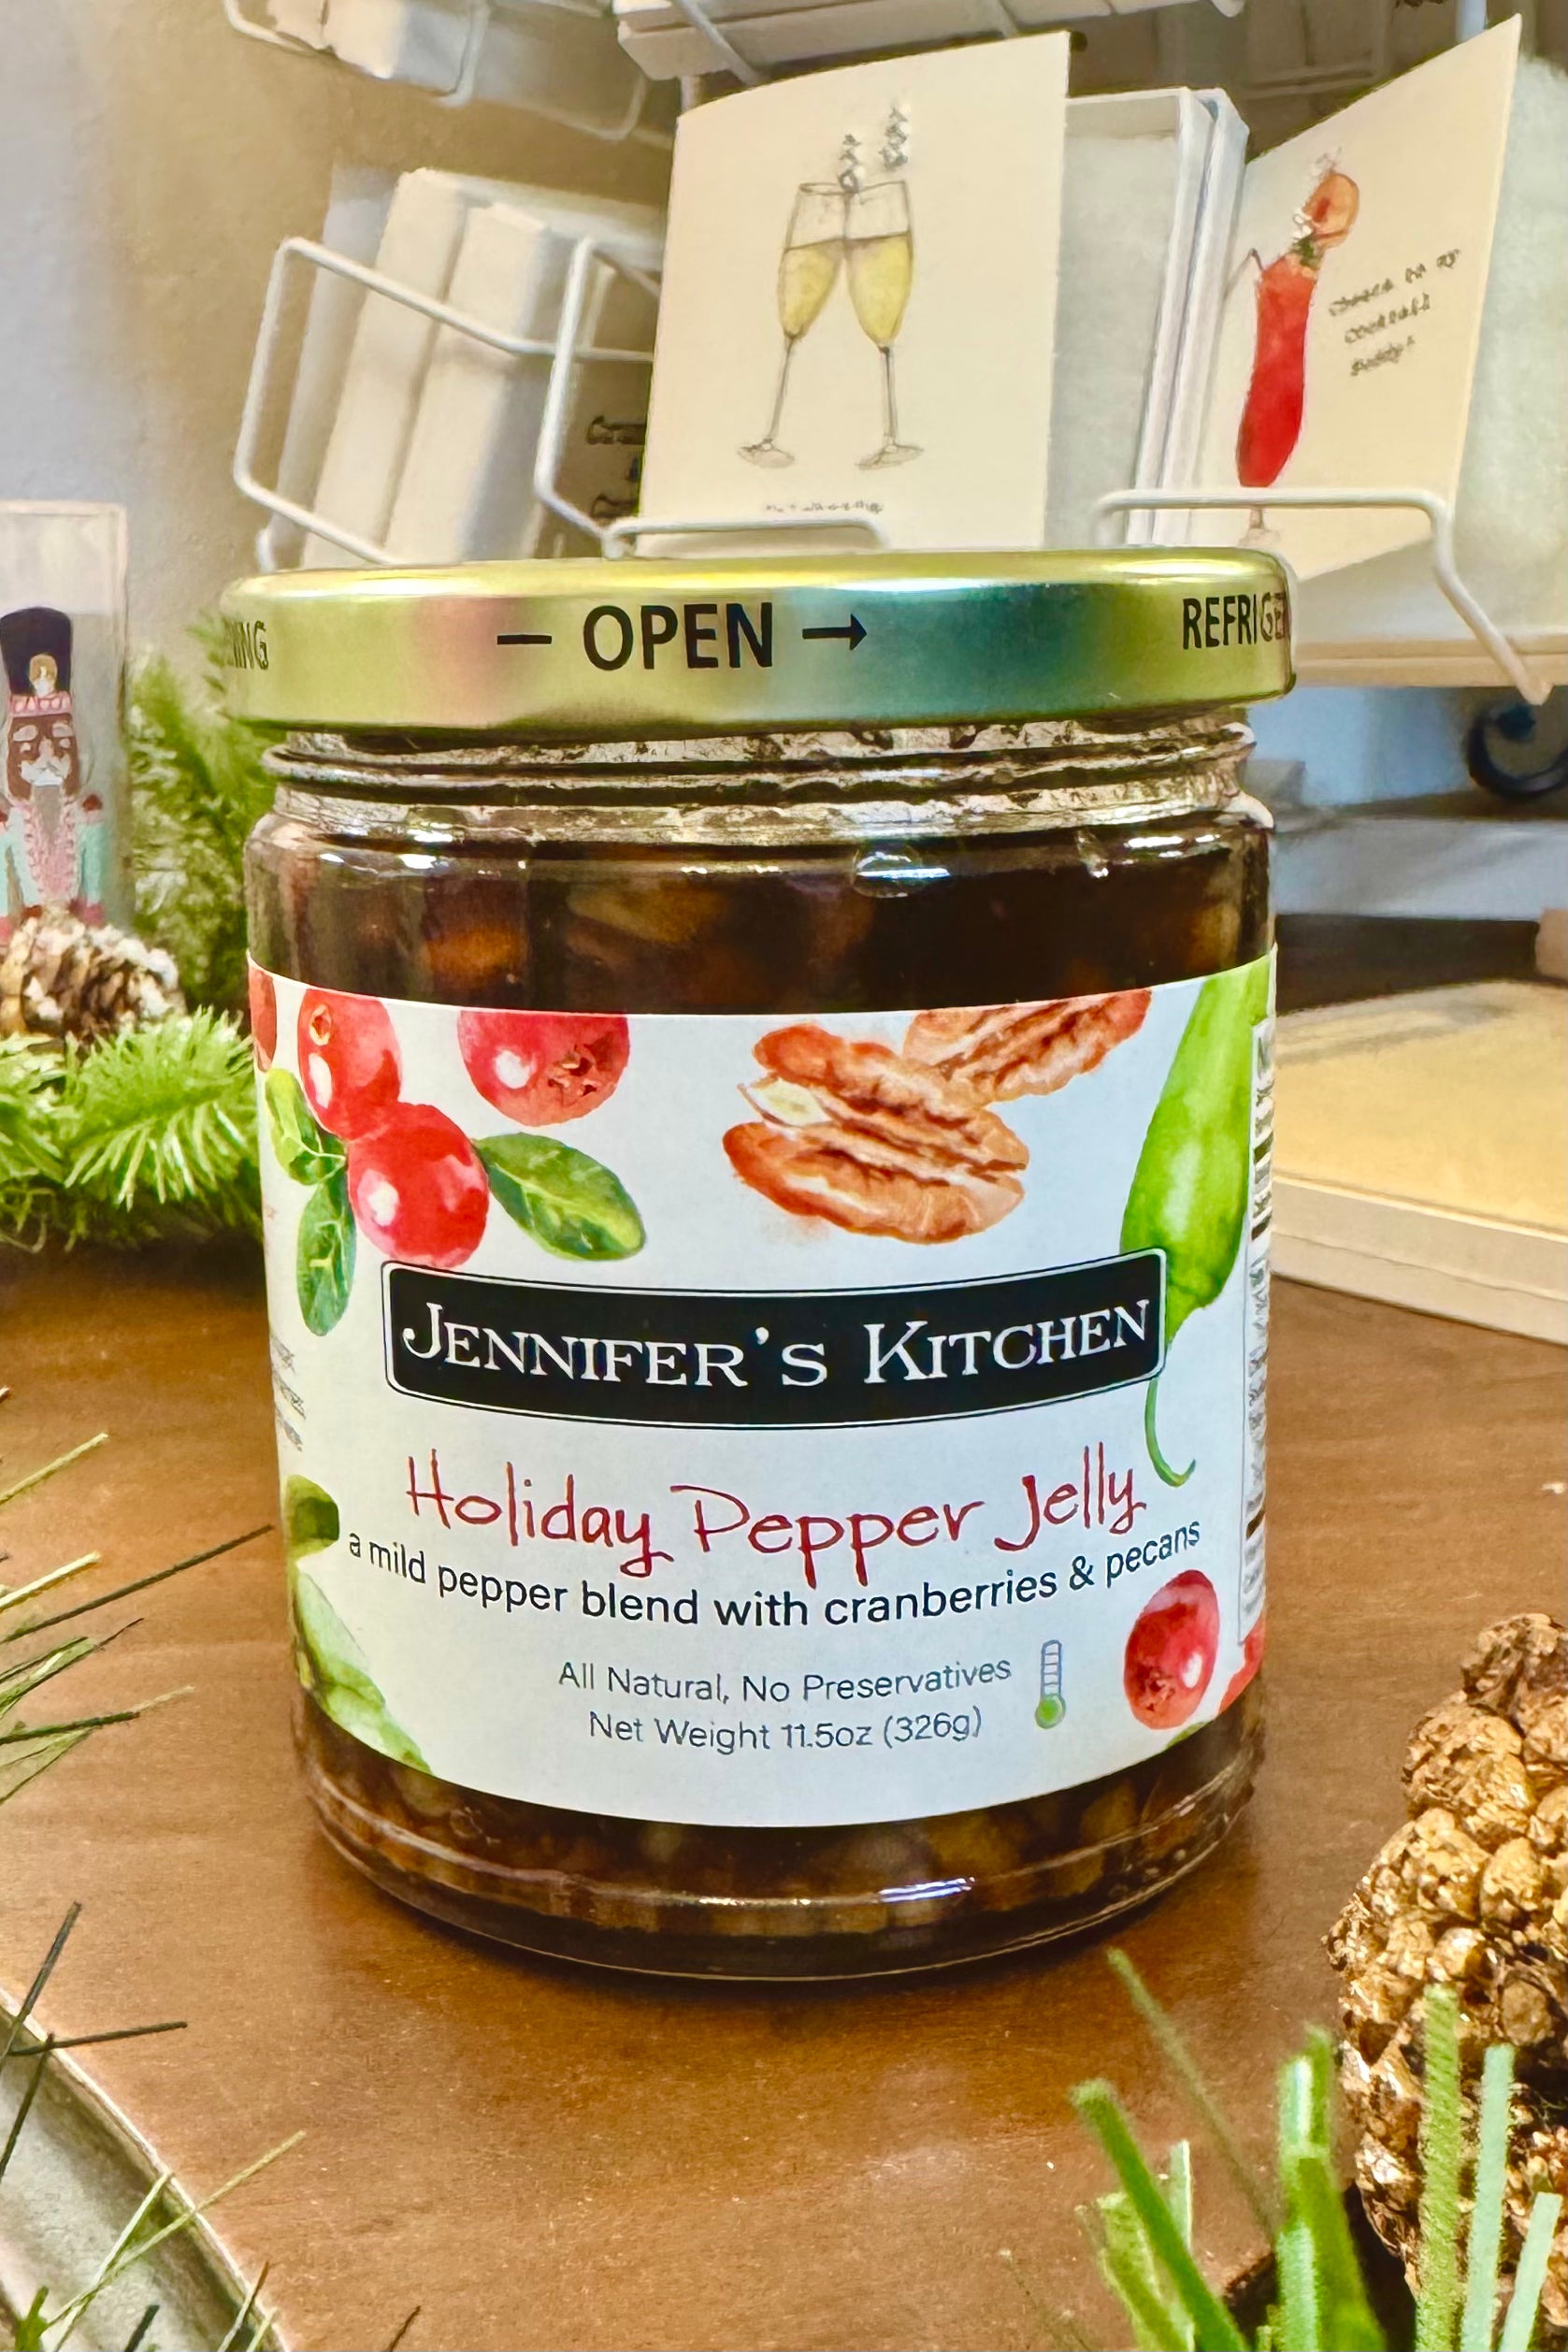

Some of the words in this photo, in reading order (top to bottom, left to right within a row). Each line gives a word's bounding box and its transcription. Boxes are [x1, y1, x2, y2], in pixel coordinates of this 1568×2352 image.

[583, 602, 772, 671] OPEN
[402, 1302, 827, 1387] JENNIFER'S
[864, 1299, 1150, 1384] KITCHEN
[406, 1449, 673, 1578] Holiday
[669, 1484, 985, 1589] Pepper
[995, 1441, 1147, 1551] Jelly
[349, 1533, 362, 1558] a
[369, 1539, 426, 1584] mild
[439, 1563, 568, 1612] pepper
[582, 1580, 698, 1624] blend
[713, 1591, 808, 1626] with
[825, 1569, 1058, 1624] cranberries
[1069, 1555, 1095, 1590] &
[1106, 1520, 1201, 1588] pecans
[558, 1662, 595, 1691] All
[608, 1667, 729, 1705] Natural,
[742, 1674, 791, 1703] No
[803, 1655, 1012, 1701] Preservatives
[590, 1711, 644, 1742] Net
[655, 1718, 770, 1756] Weight
[781, 1724, 873, 1749] 11.5oz
[883, 1706, 983, 1749] (326g)
